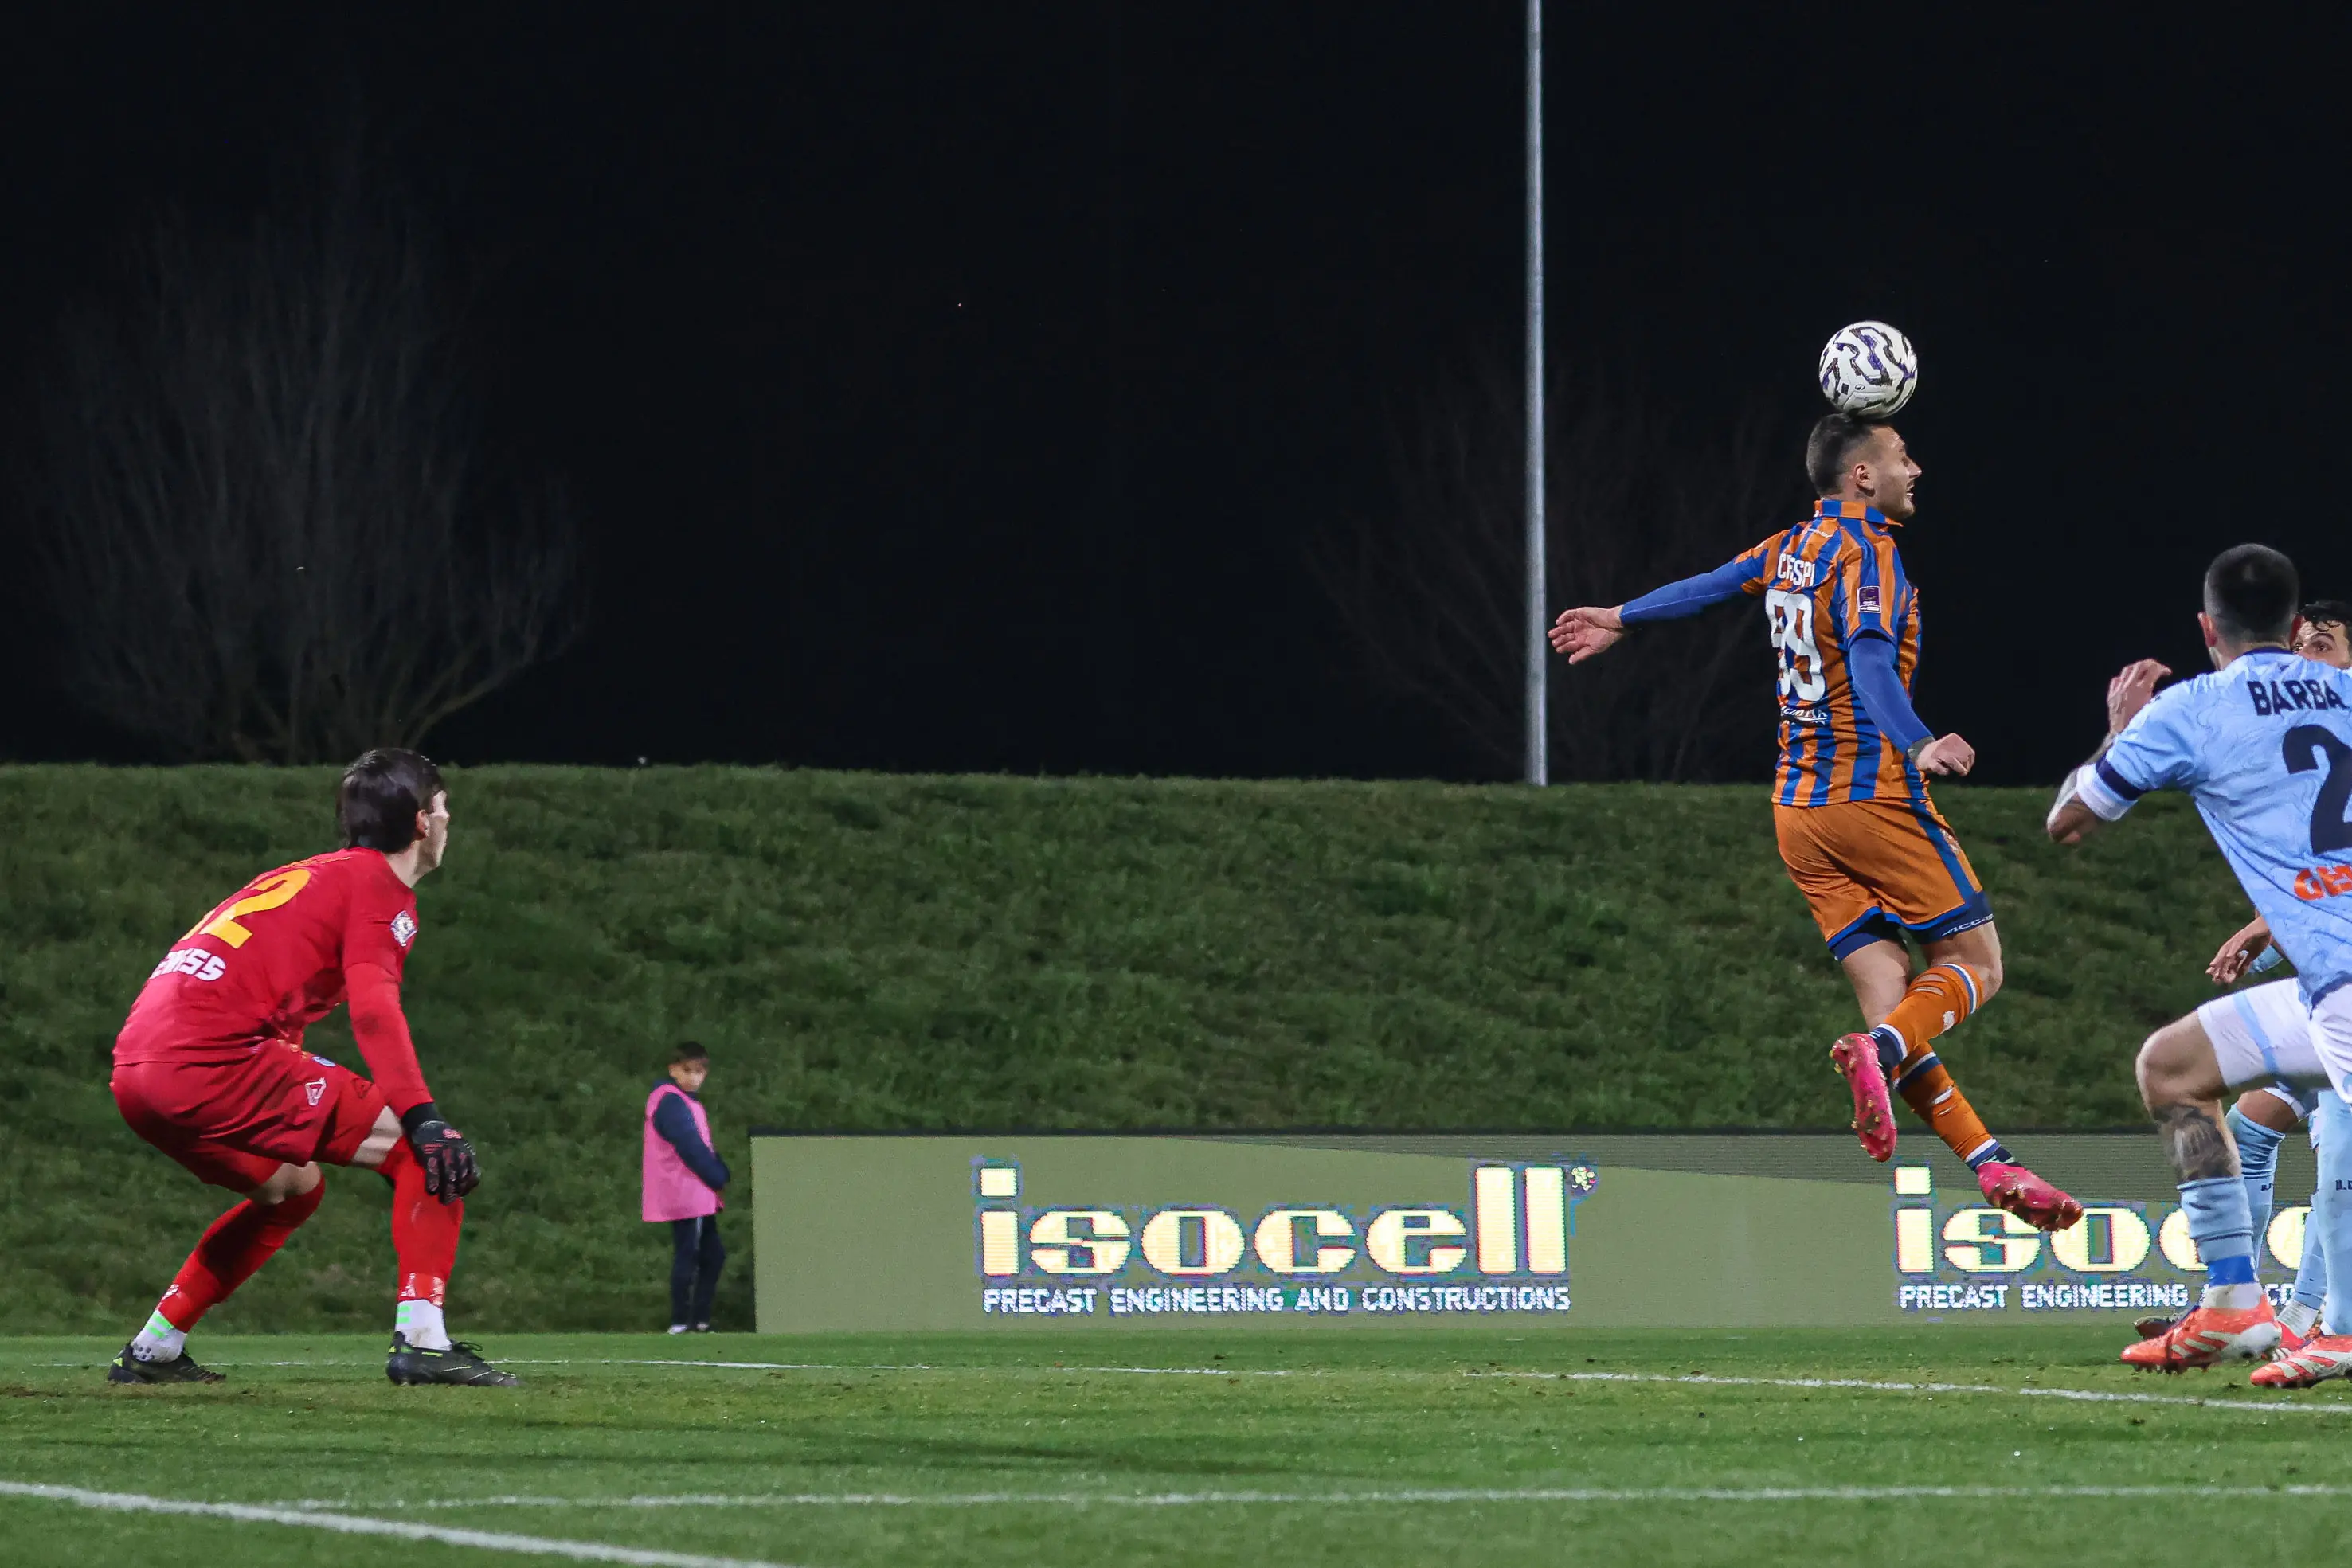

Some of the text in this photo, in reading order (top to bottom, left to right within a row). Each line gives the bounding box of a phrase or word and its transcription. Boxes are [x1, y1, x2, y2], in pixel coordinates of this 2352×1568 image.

[2247, 679, 2350, 716] BARBA
[980, 1167, 1567, 1276] isocell
[983, 1286, 1571, 1312] PRECAST ENGINEERING AND CONSTRUCTIONS
[1899, 1285, 2008, 1308] PRECAST
[2021, 1284, 2188, 1308] ENGINEERING
